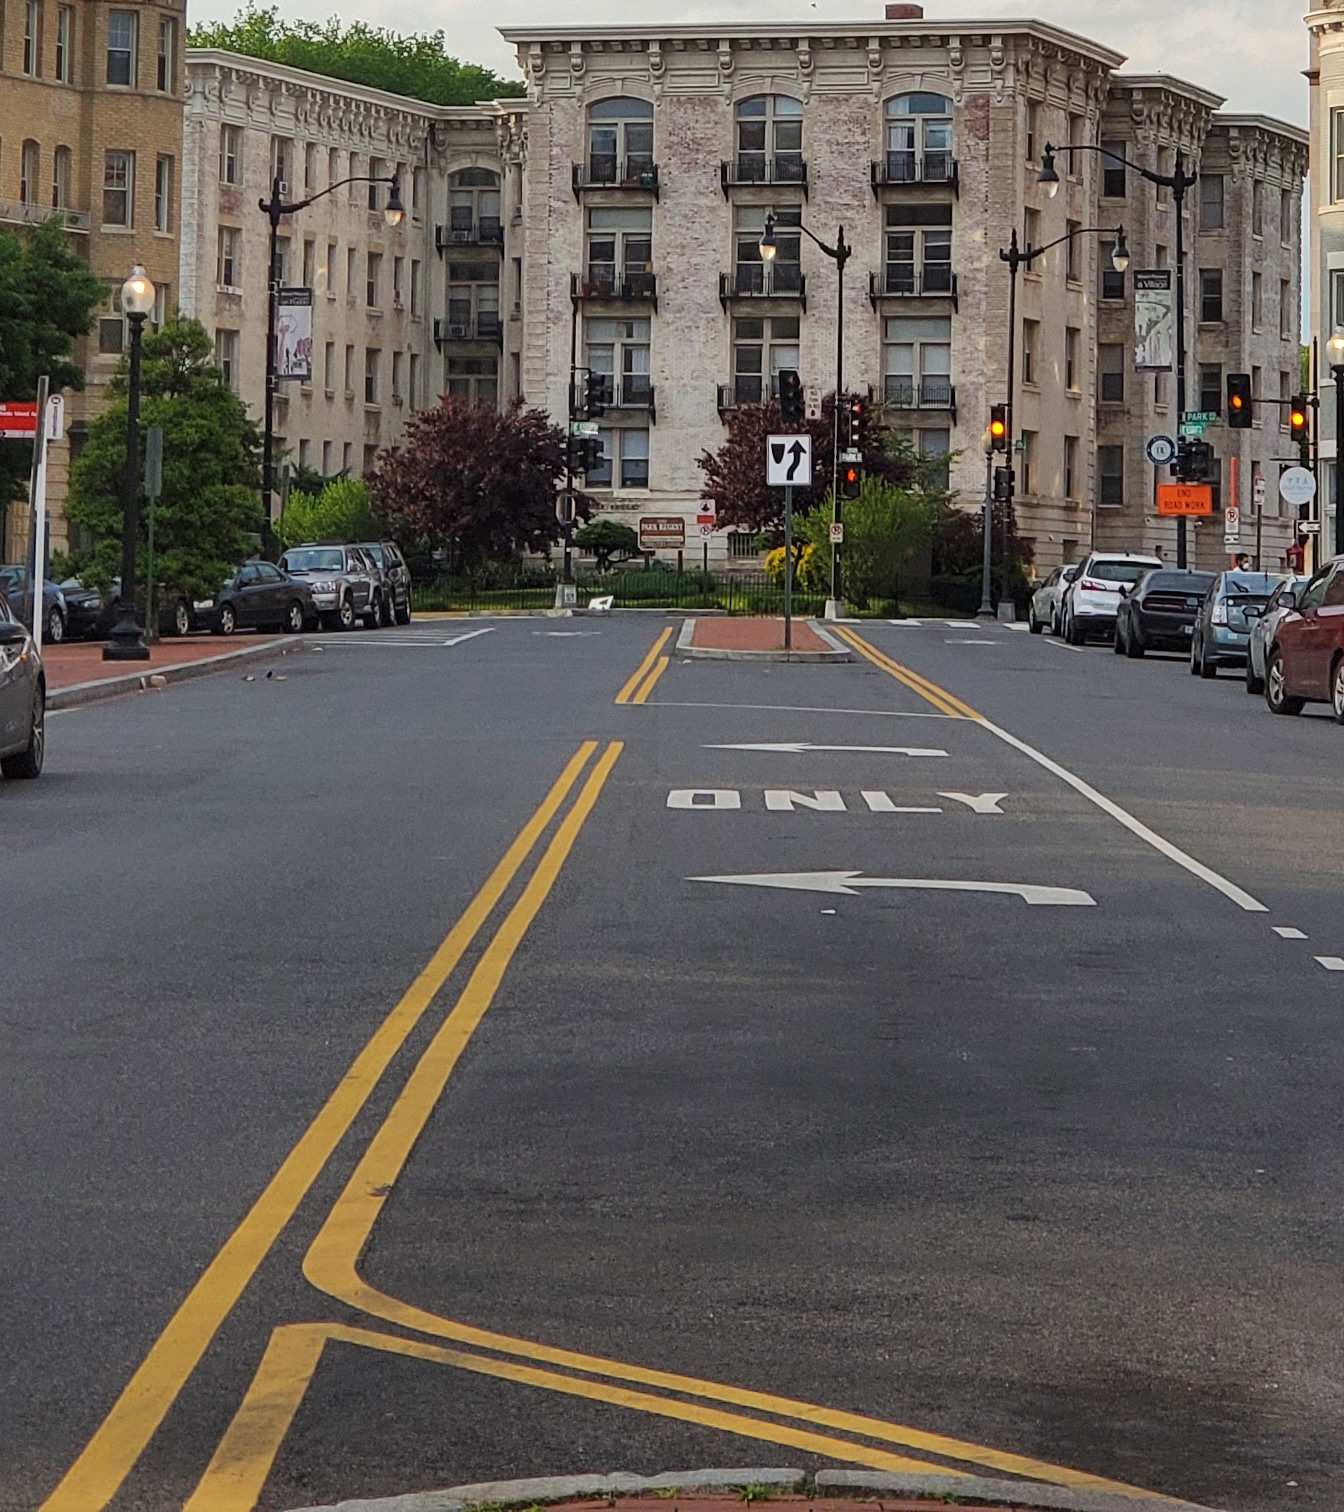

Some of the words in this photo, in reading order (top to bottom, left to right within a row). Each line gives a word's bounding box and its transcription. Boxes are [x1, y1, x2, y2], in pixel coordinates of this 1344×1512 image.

[1187, 413, 1209, 422] PARK
[1177, 489, 1192, 498] END
[1164, 500, 1183, 509] ROAD
[1184, 500, 1206, 510] WORK
[666, 789, 1009, 814] ONLY
